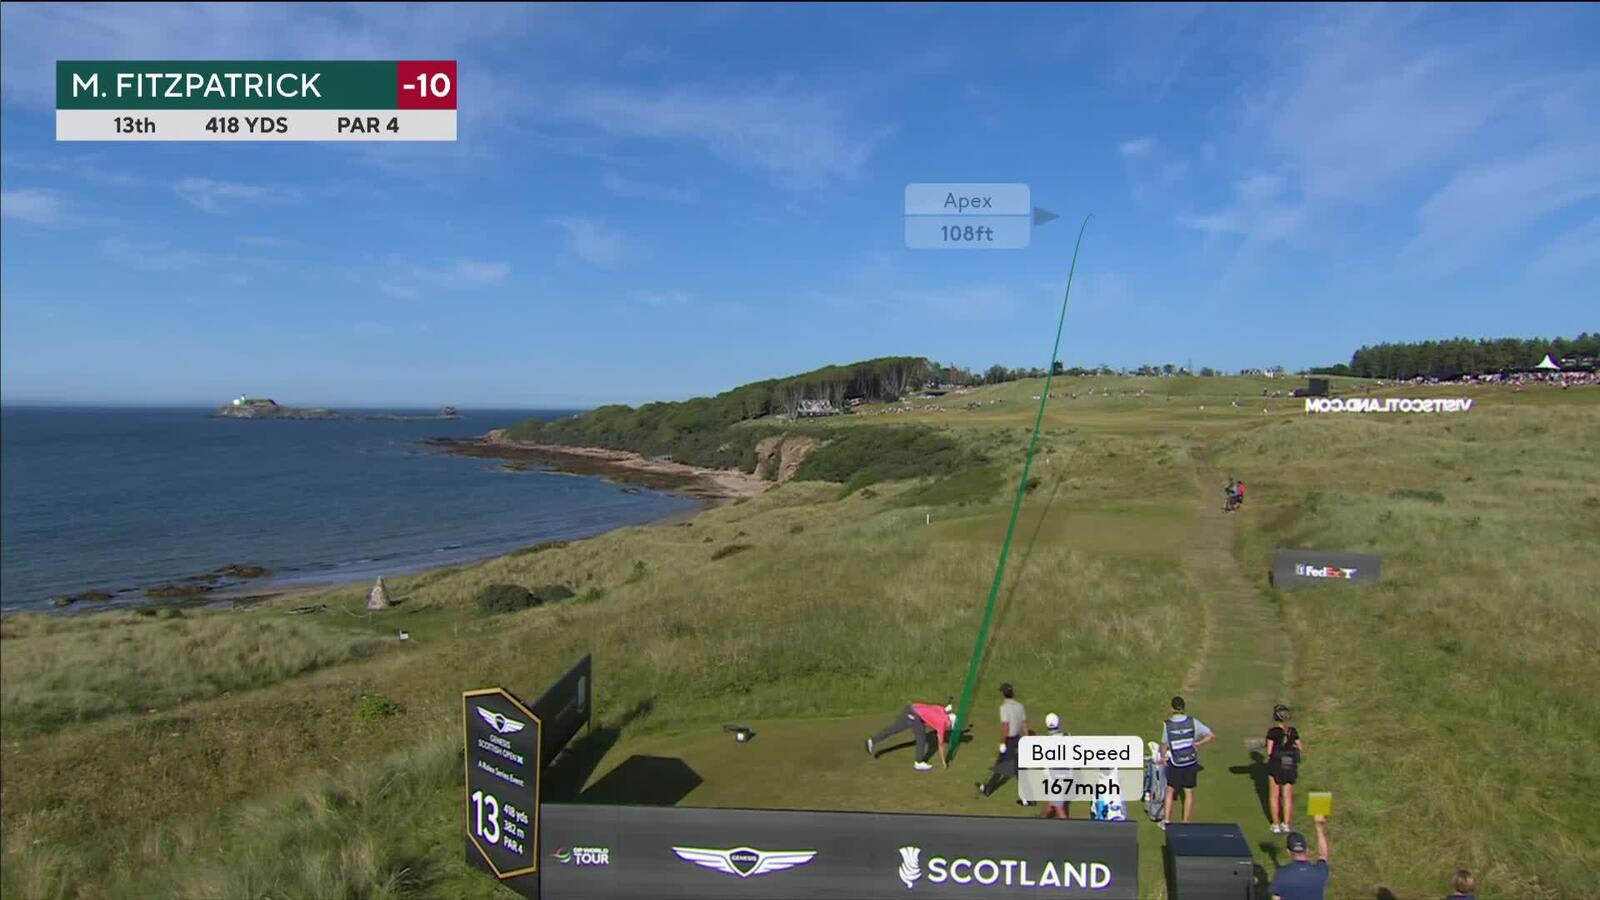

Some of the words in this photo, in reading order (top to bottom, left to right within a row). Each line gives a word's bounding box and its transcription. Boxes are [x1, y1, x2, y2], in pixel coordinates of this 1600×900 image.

[1306, 566, 1341, 578] FedEx
[472, 790, 500, 844] 13
[503, 804, 516, 818] 418
[515, 811, 529, 825] yds
[503, 820, 516, 835] 382
[503, 835, 518, 852] PAR
[574, 853, 609, 865] TOUR
[927, 857, 1112, 889] SCOTLAND
